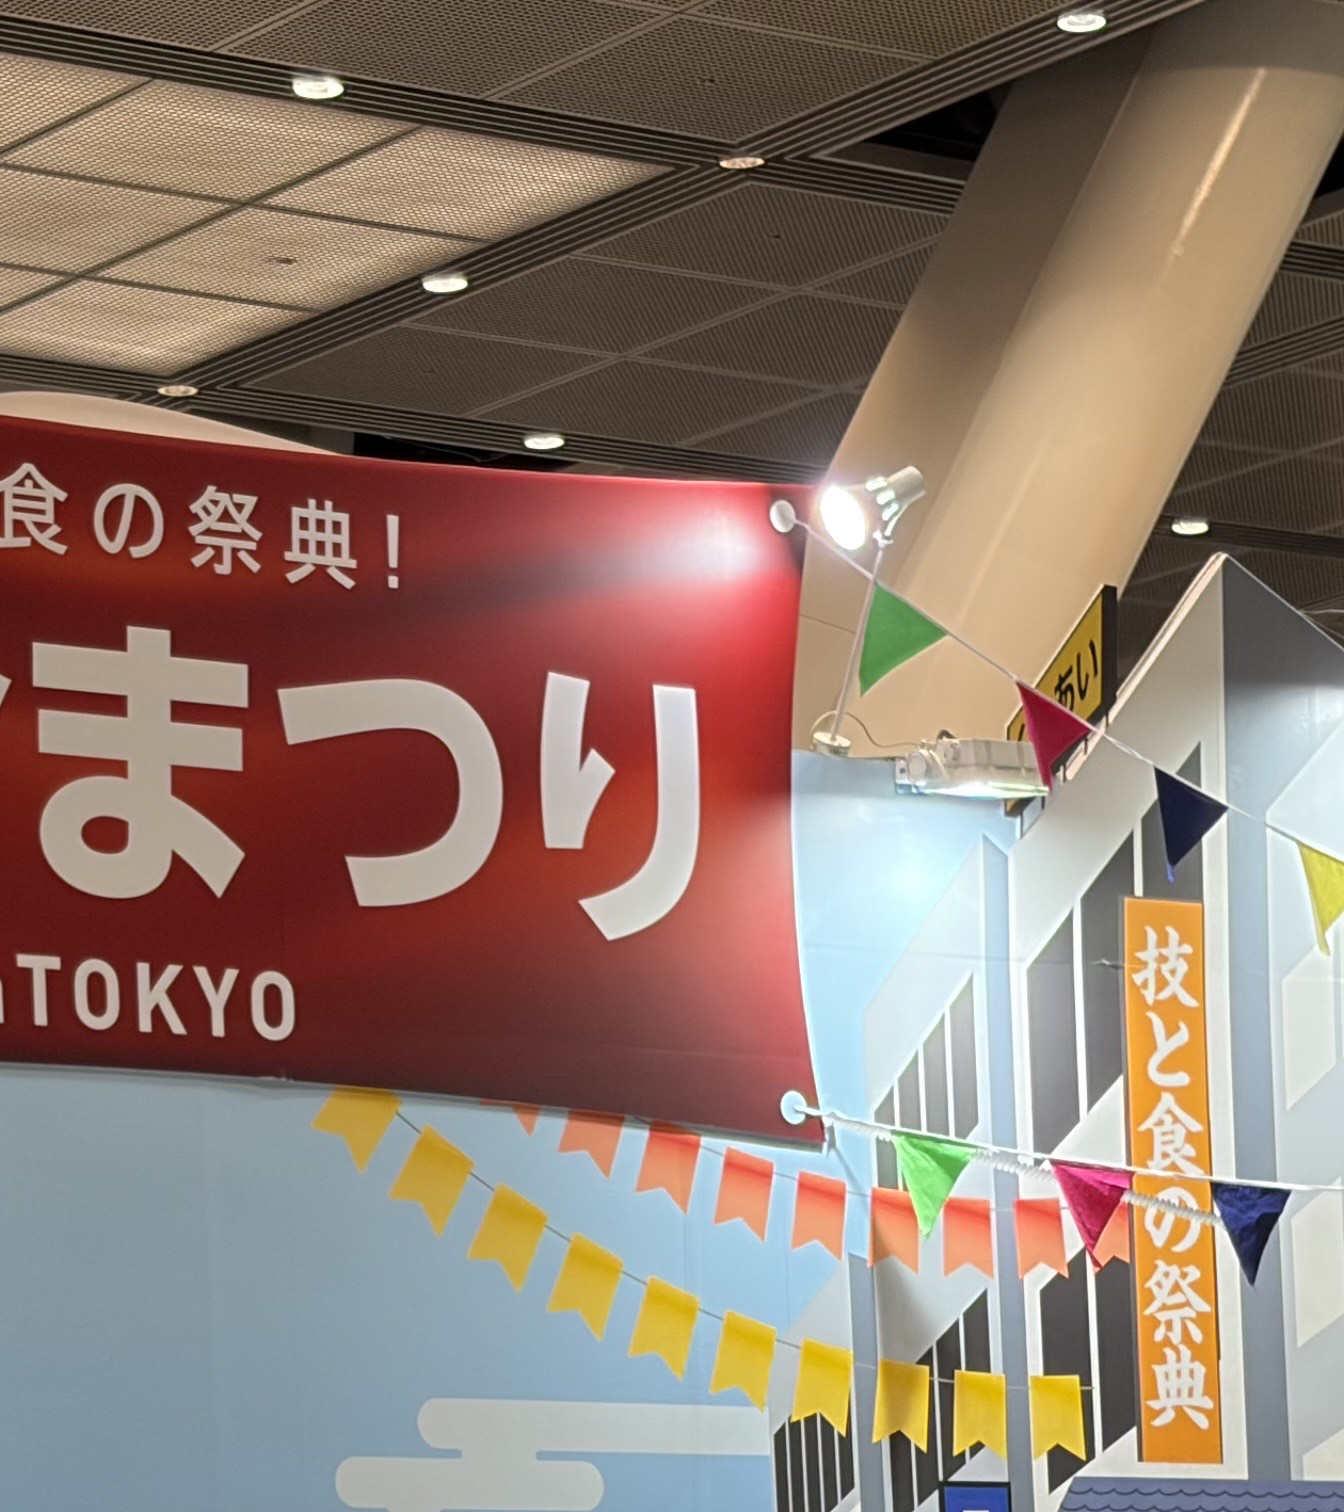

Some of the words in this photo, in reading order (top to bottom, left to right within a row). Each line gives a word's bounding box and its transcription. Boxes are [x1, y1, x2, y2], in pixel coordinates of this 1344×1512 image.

[1132, 926, 1214, 1429] 技と食の祭典
